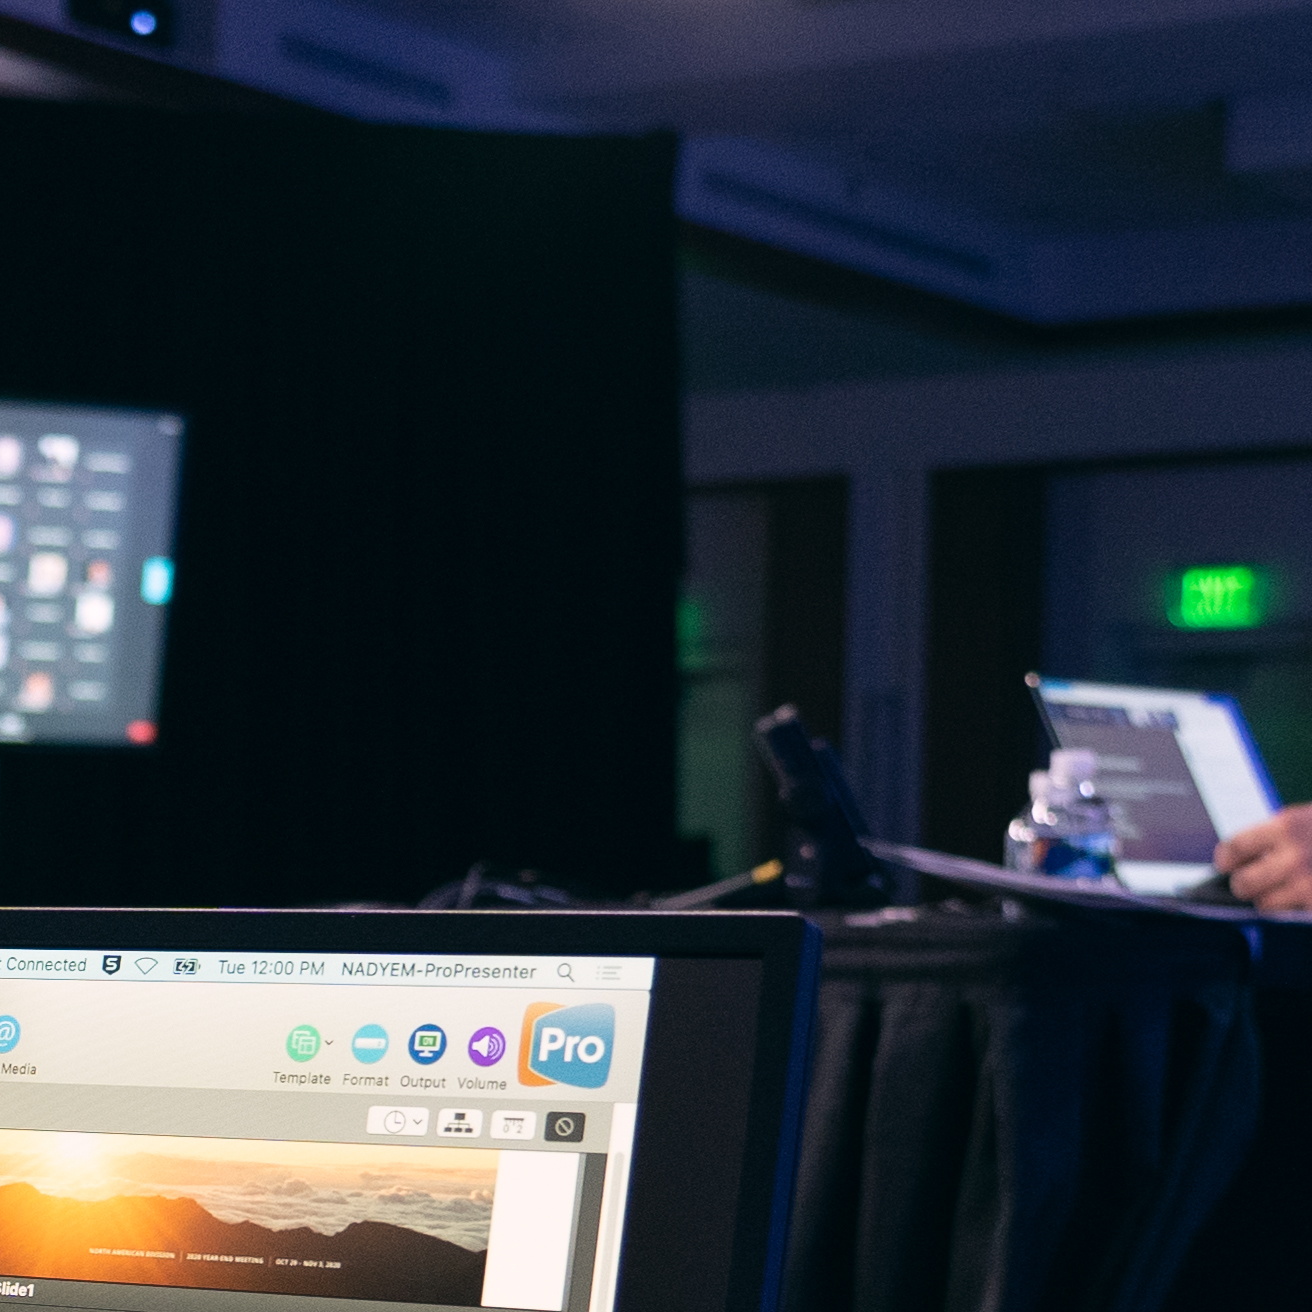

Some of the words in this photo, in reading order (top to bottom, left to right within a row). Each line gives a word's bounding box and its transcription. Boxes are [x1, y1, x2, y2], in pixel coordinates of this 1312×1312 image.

[6, 956, 87, 972] Connected
[218, 958, 245, 975] Tue
[252, 959, 294, 975] 12:00
[299, 960, 325, 975] PM
[341, 961, 534, 978] NADYEM-ProPresenter
[538, 1026, 604, 1063] Pro
[1, 1062, 36, 1075] Media
[274, 1070, 331, 1085] Template
[342, 1072, 389, 1087] Format
[399, 1074, 446, 1089] Output
[457, 1077, 507, 1090] Volume
